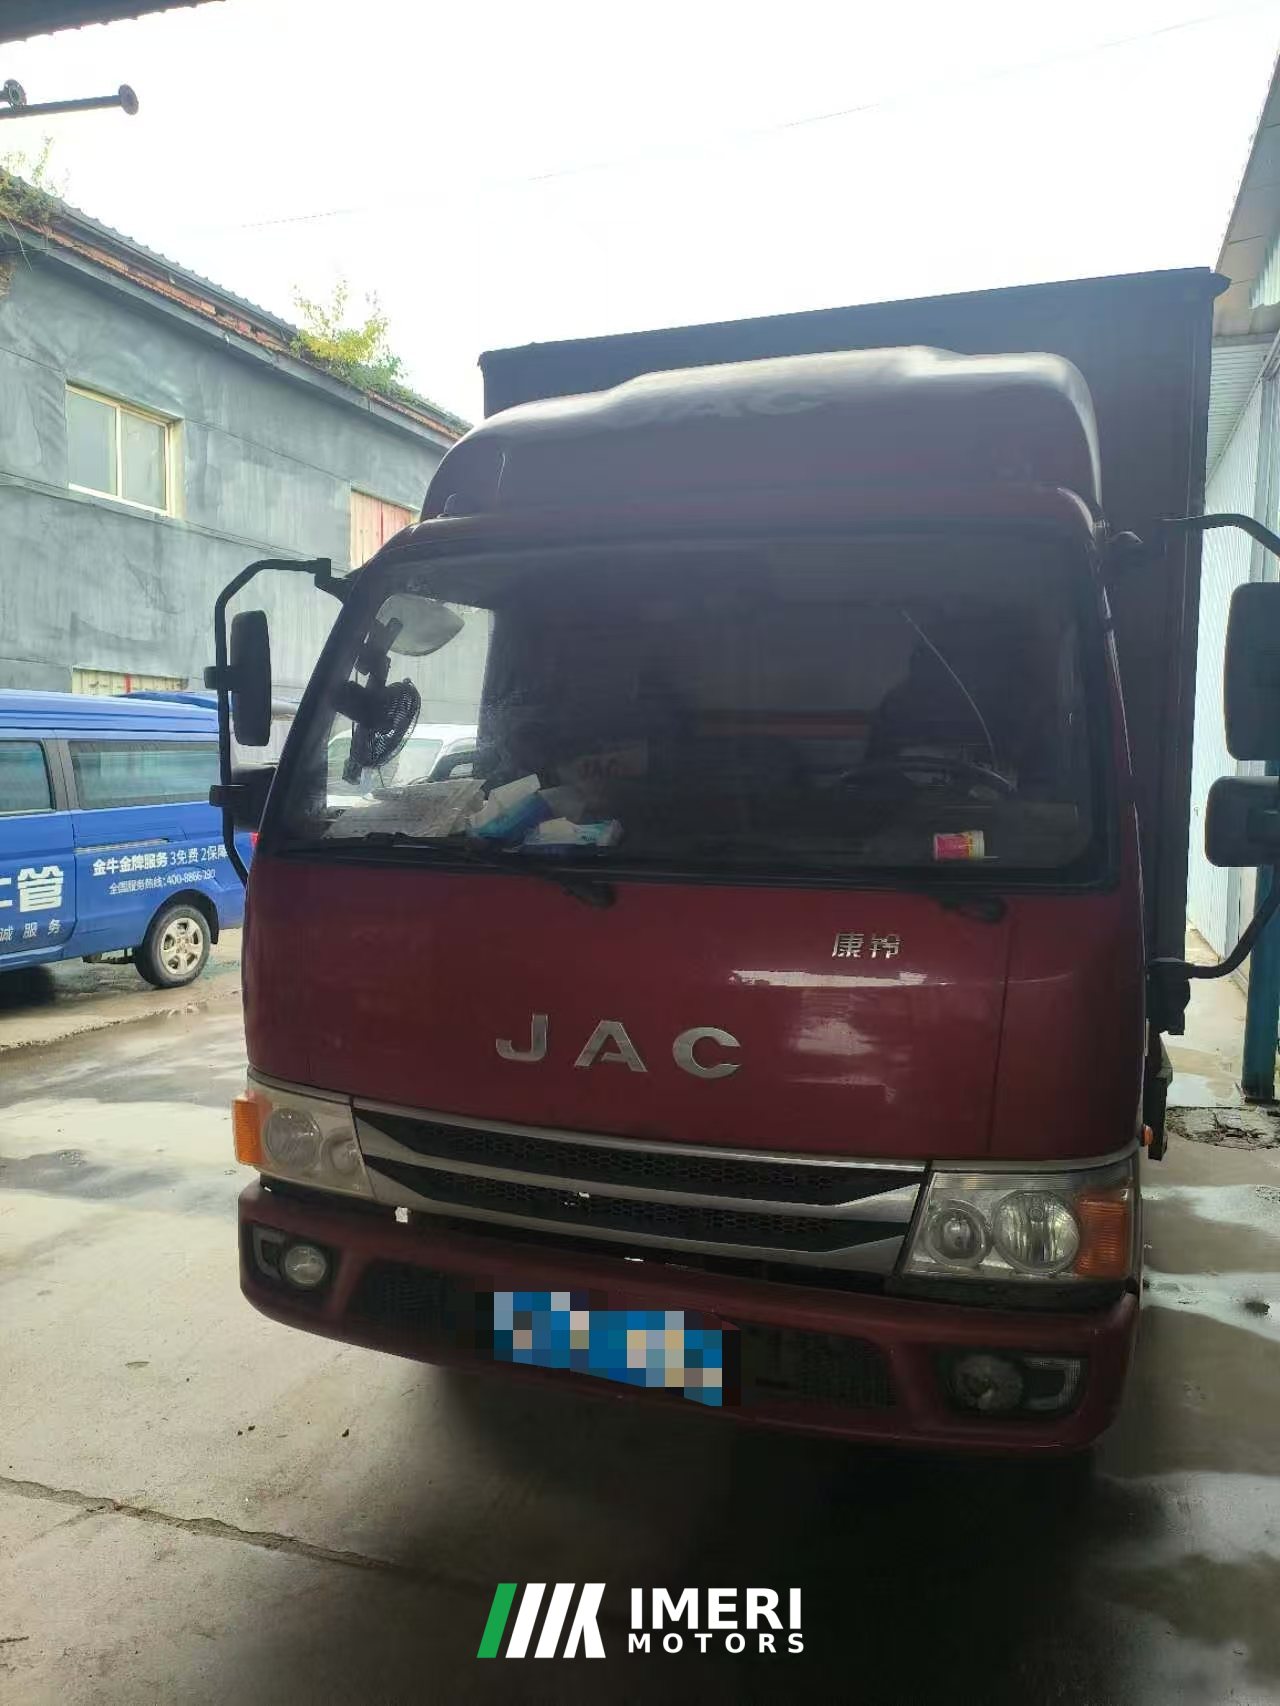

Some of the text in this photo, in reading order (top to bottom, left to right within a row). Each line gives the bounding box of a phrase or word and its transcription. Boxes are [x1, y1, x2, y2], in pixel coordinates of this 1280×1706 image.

[92, 852, 168, 876] 金牛金牌服务
[831, 932, 900, 959] 康铃
[495, 1014, 741, 1079] JAC
